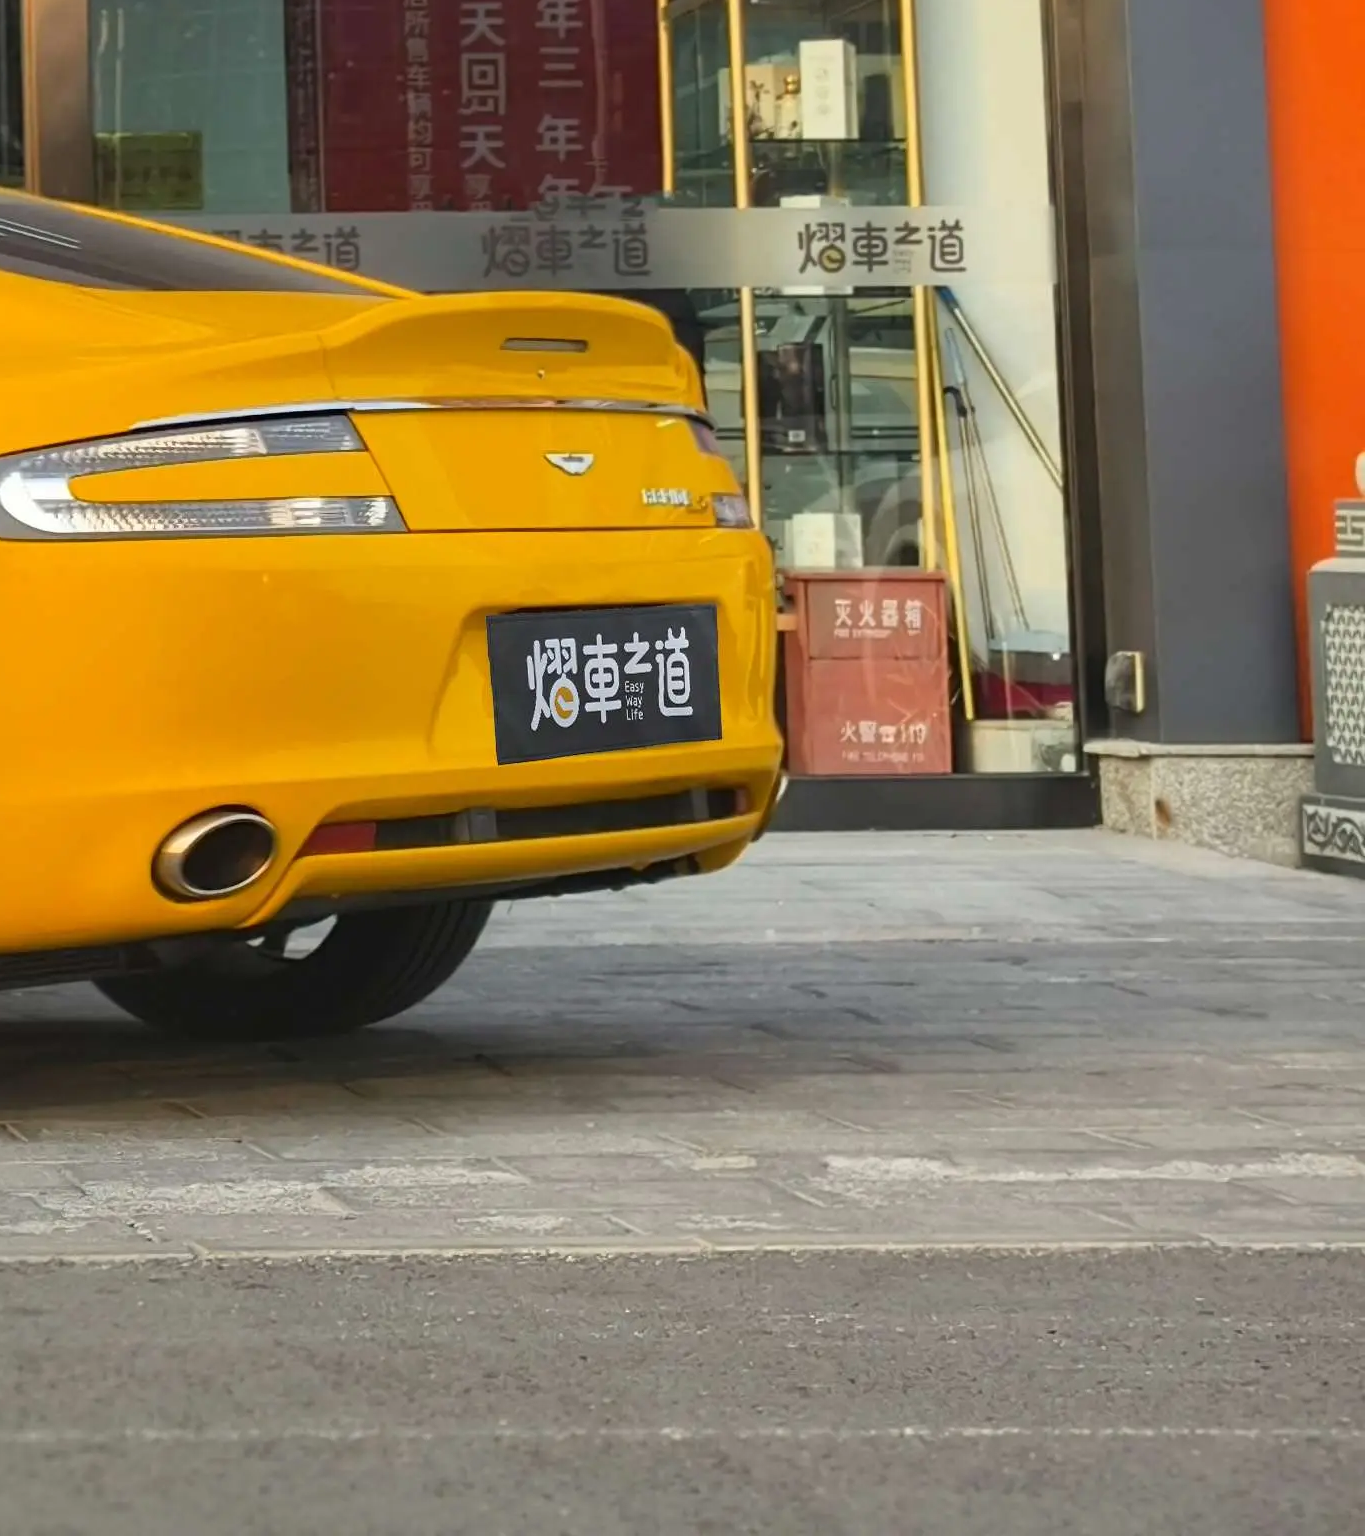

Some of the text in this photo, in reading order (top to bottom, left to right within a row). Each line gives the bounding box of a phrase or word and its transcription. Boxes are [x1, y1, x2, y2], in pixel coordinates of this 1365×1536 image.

[834, 598, 922, 629] 灭火器箱
[624, 679, 645, 695] Easy
[625, 694, 644, 710] Way
[625, 709, 644, 721] Life
